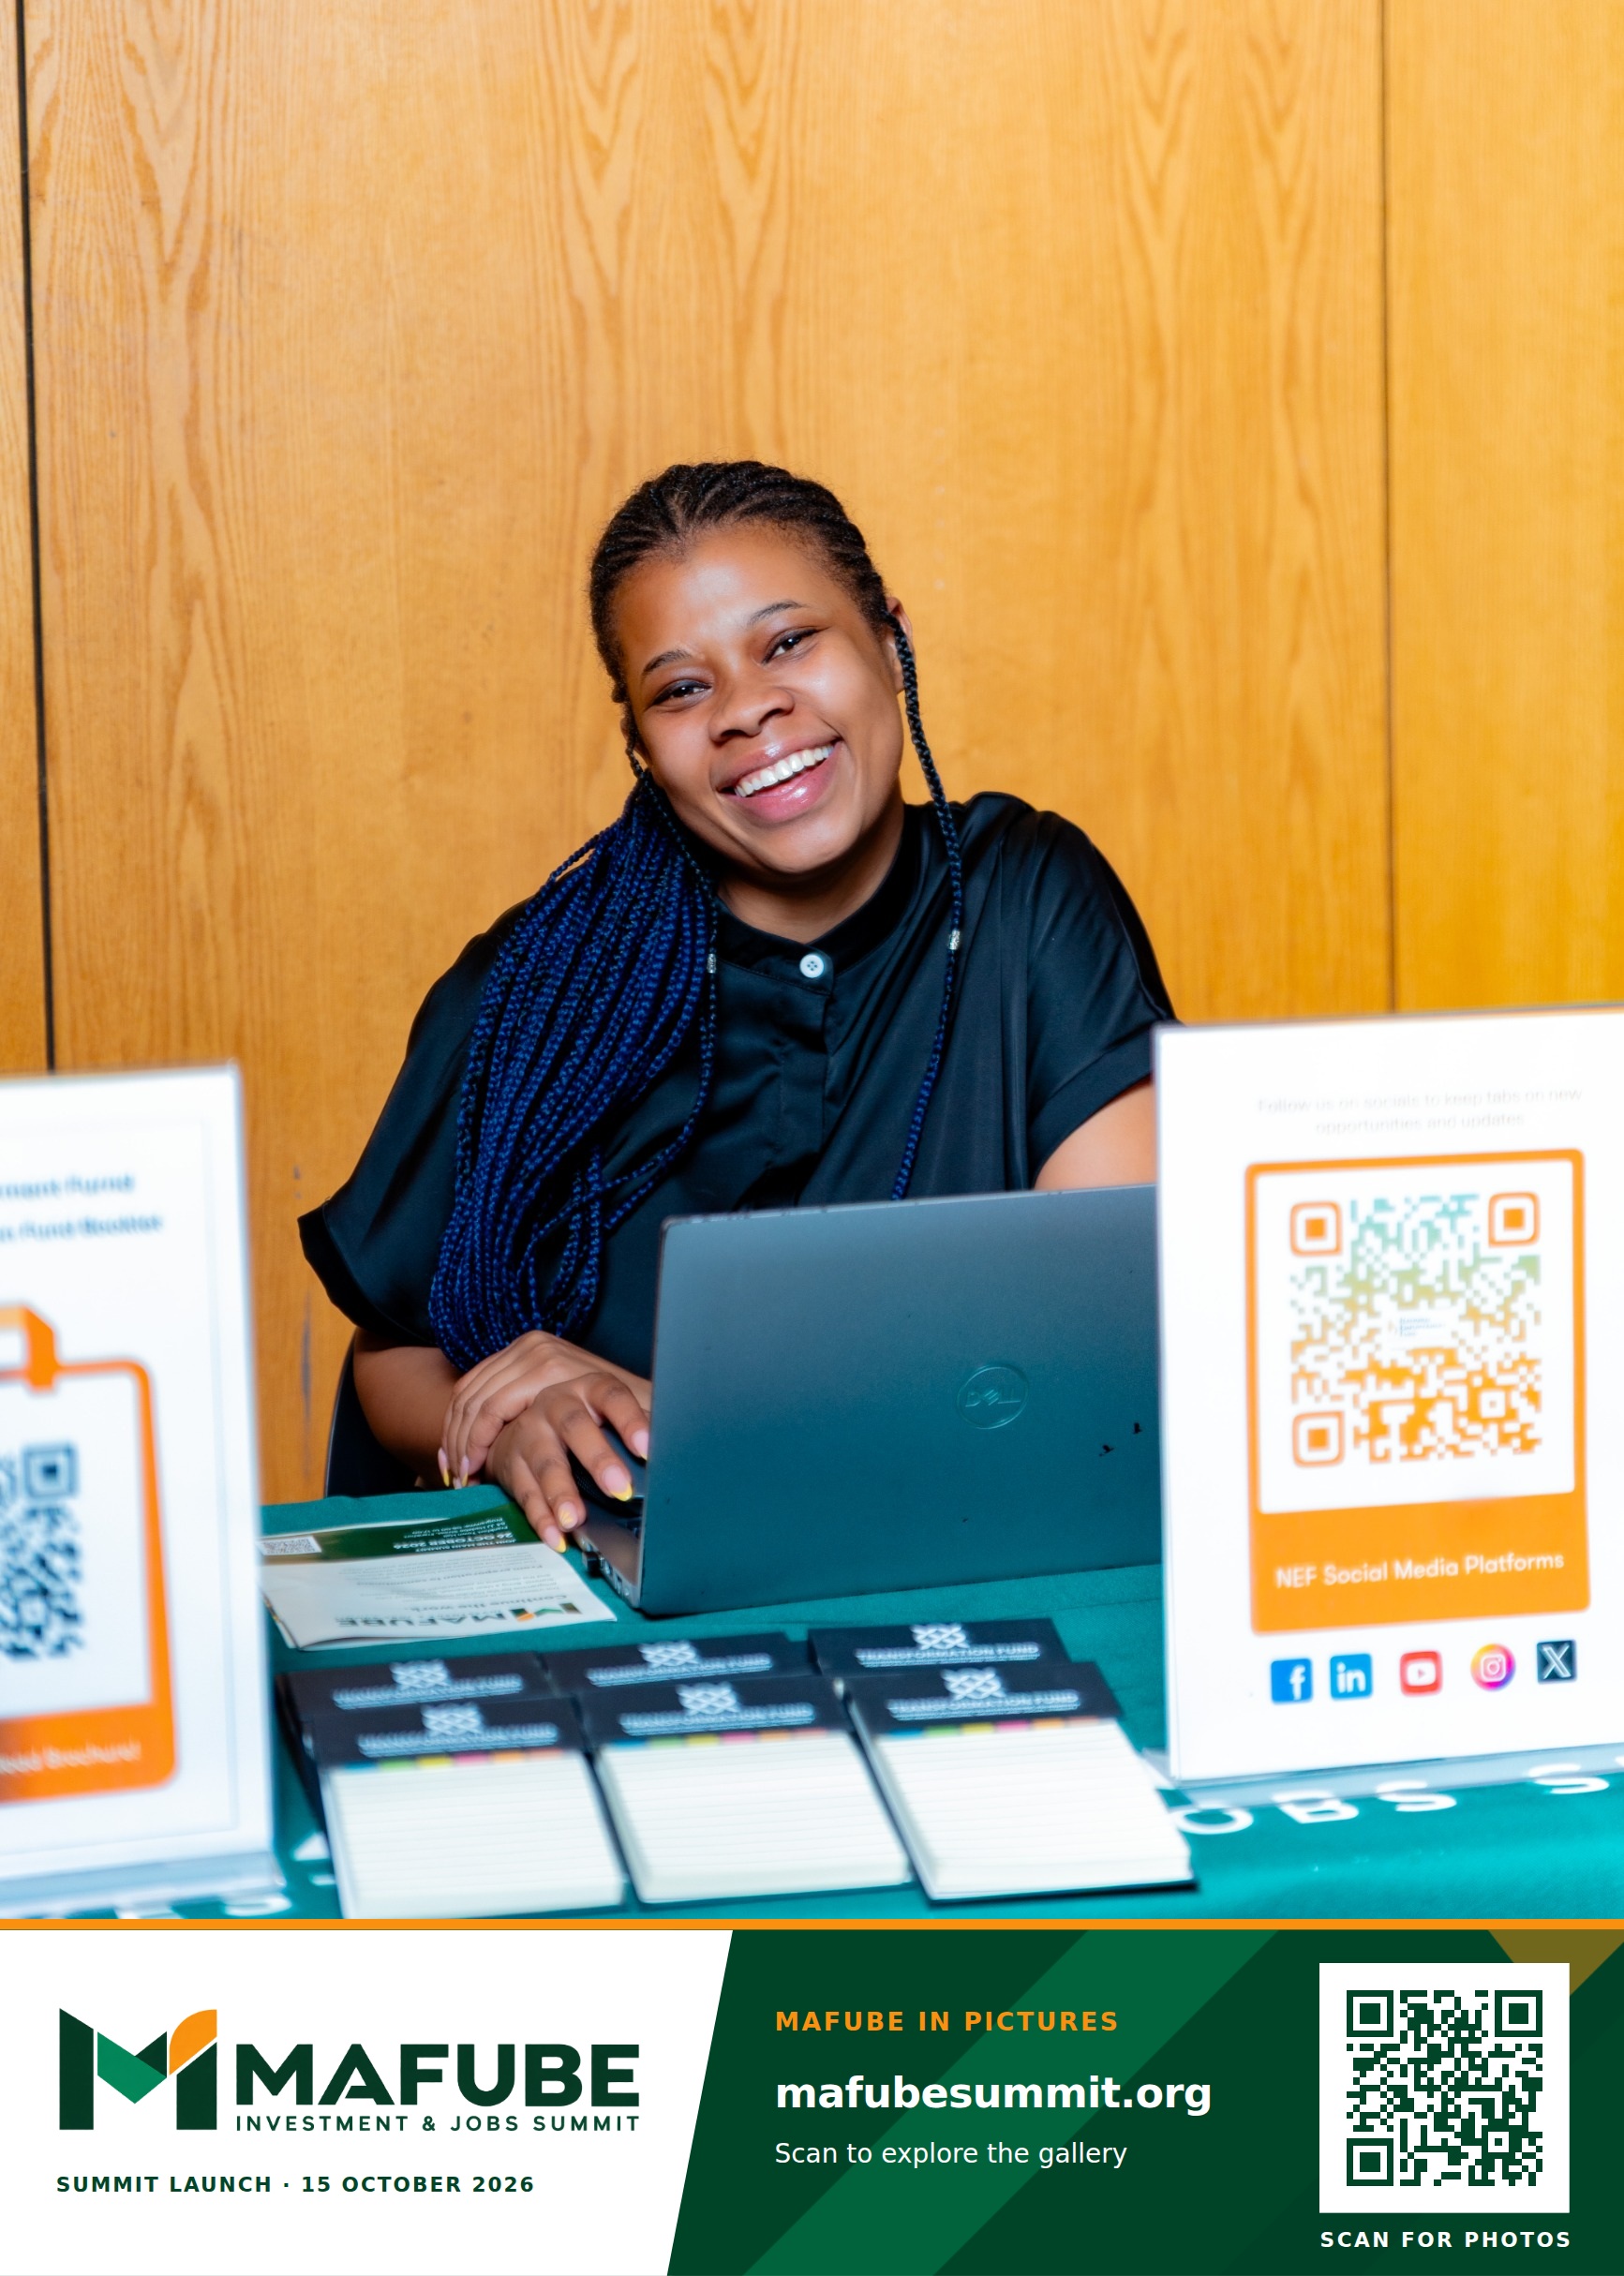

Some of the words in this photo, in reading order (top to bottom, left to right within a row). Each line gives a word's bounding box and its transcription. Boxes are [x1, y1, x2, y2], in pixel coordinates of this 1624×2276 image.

[1259, 1098, 1311, 1114] Follow
[1317, 1100, 1333, 1111] us
[1339, 1099, 1359, 1110] on
[1364, 1094, 1420, 1109] socials
[1424, 1094, 1439, 1108] to
[1445, 1092, 1483, 1108] keep
[1487, 1090, 1520, 1105] tabs
[1525, 1090, 1544, 1103] on
[1548, 1088, 1583, 1102] new
[1316, 1116, 1423, 1136] opportunities
[1427, 1115, 1456, 1130] and
[1461, 1111, 1525, 1130] updates
[965, 1388, 1021, 1407] DELL
[429, 1535, 495, 1546] OCTOBER
[1275, 1566, 1317, 1588] NEF
[1323, 1561, 1388, 1585] Social
[1394, 1557, 1458, 1579] Media
[1466, 1552, 1564, 1575] Platforms
[490, 1595, 567, 1606] Continue
[337, 1614, 507, 1627] MAFUBE
[857, 1646, 995, 1663] TRANSFORMATION
[997, 1642, 1039, 1658] FUND
[1174, 1779, 1457, 1835] OBS
